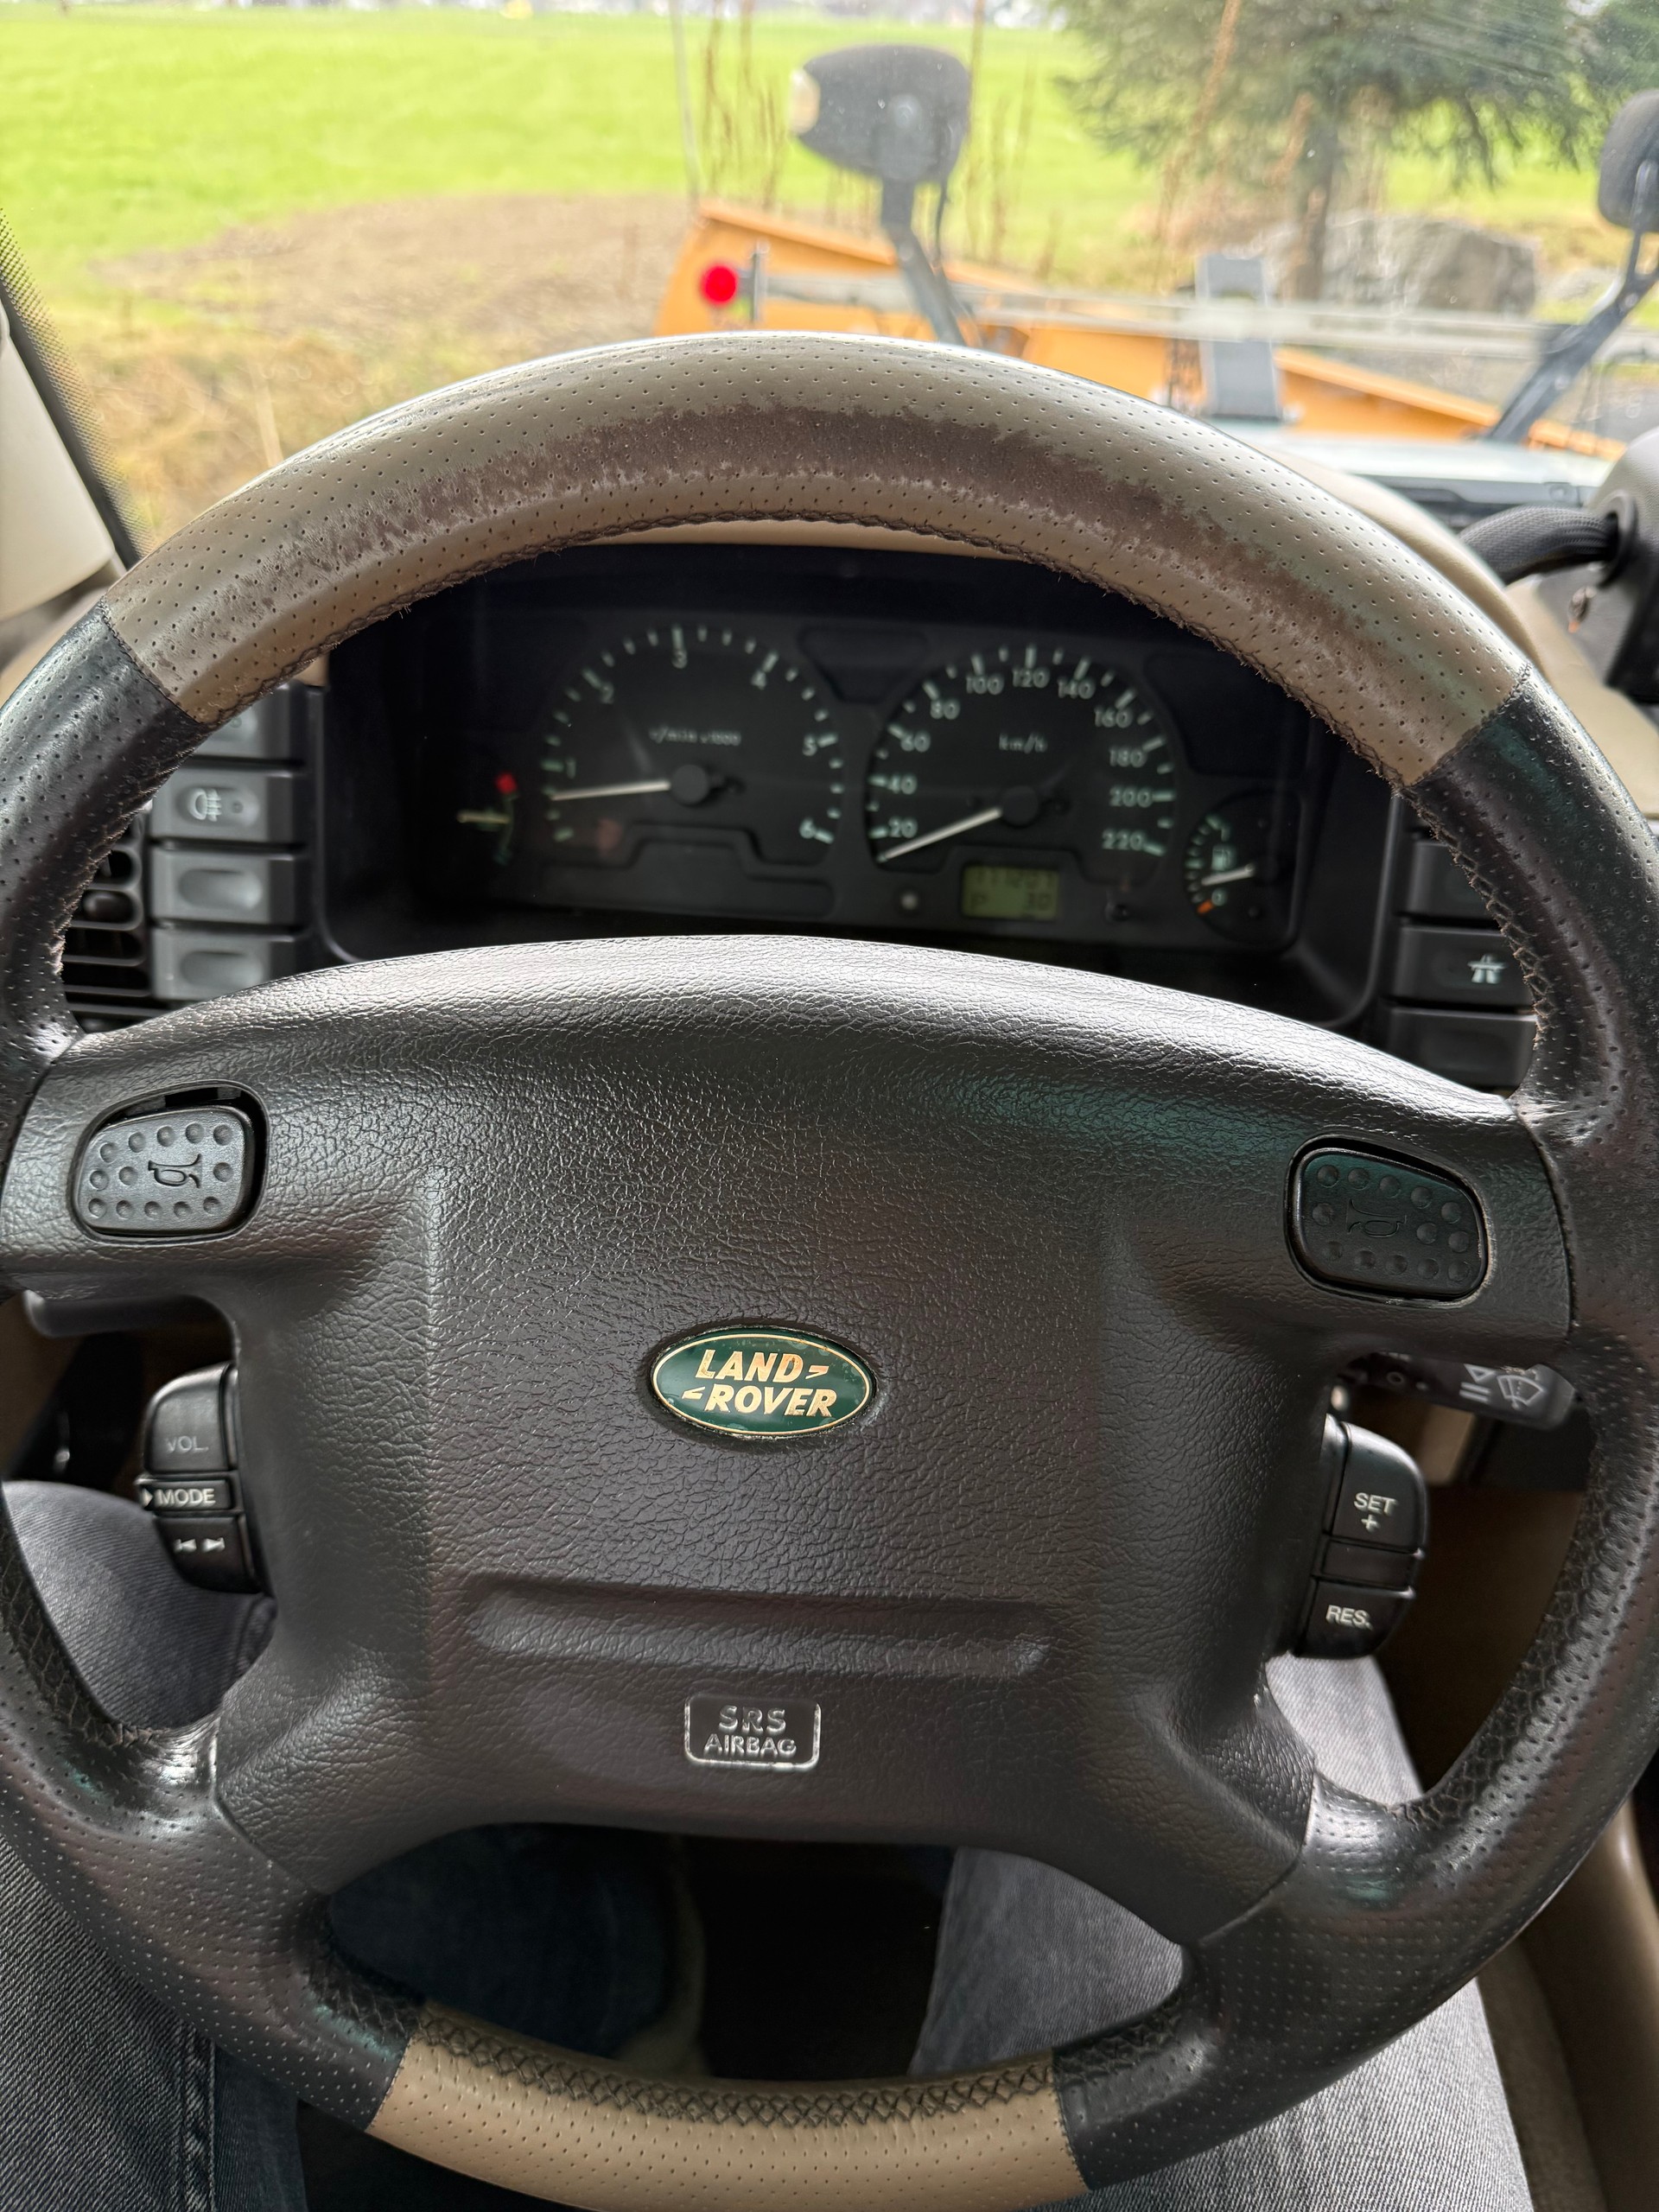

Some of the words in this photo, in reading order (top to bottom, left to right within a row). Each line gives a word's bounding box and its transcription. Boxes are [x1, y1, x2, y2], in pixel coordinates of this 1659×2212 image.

[672, 651, 688, 669] 3
[751, 668, 767, 690] 4
[966, 674, 1004, 696] 100
[1013, 667, 1050, 689] 120
[1058, 677, 1096, 699] 140
[931, 698, 961, 720] 80
[1094, 706, 1133, 728] 160
[803, 734, 817, 756] 5
[900, 731, 931, 753] 60
[999, 733, 1048, 754] km/h
[1109, 747, 1147, 768] 180
[887, 773, 917, 795] 40
[1109, 786, 1154, 808] 200
[799, 817, 817, 839] 6
[888, 817, 917, 838] 20
[1103, 829, 1146, 850] 220
[696, 1349, 804, 1382] LAND
[704, 1383, 837, 1417] ROVER
[156, 1488, 216, 1508] MODE
[1354, 1492, 1398, 1514] SET
[1325, 1605, 1372, 1630] RES.
[719, 1704, 786, 1735] SRS
[703, 1732, 798, 1758] AIRBAG
